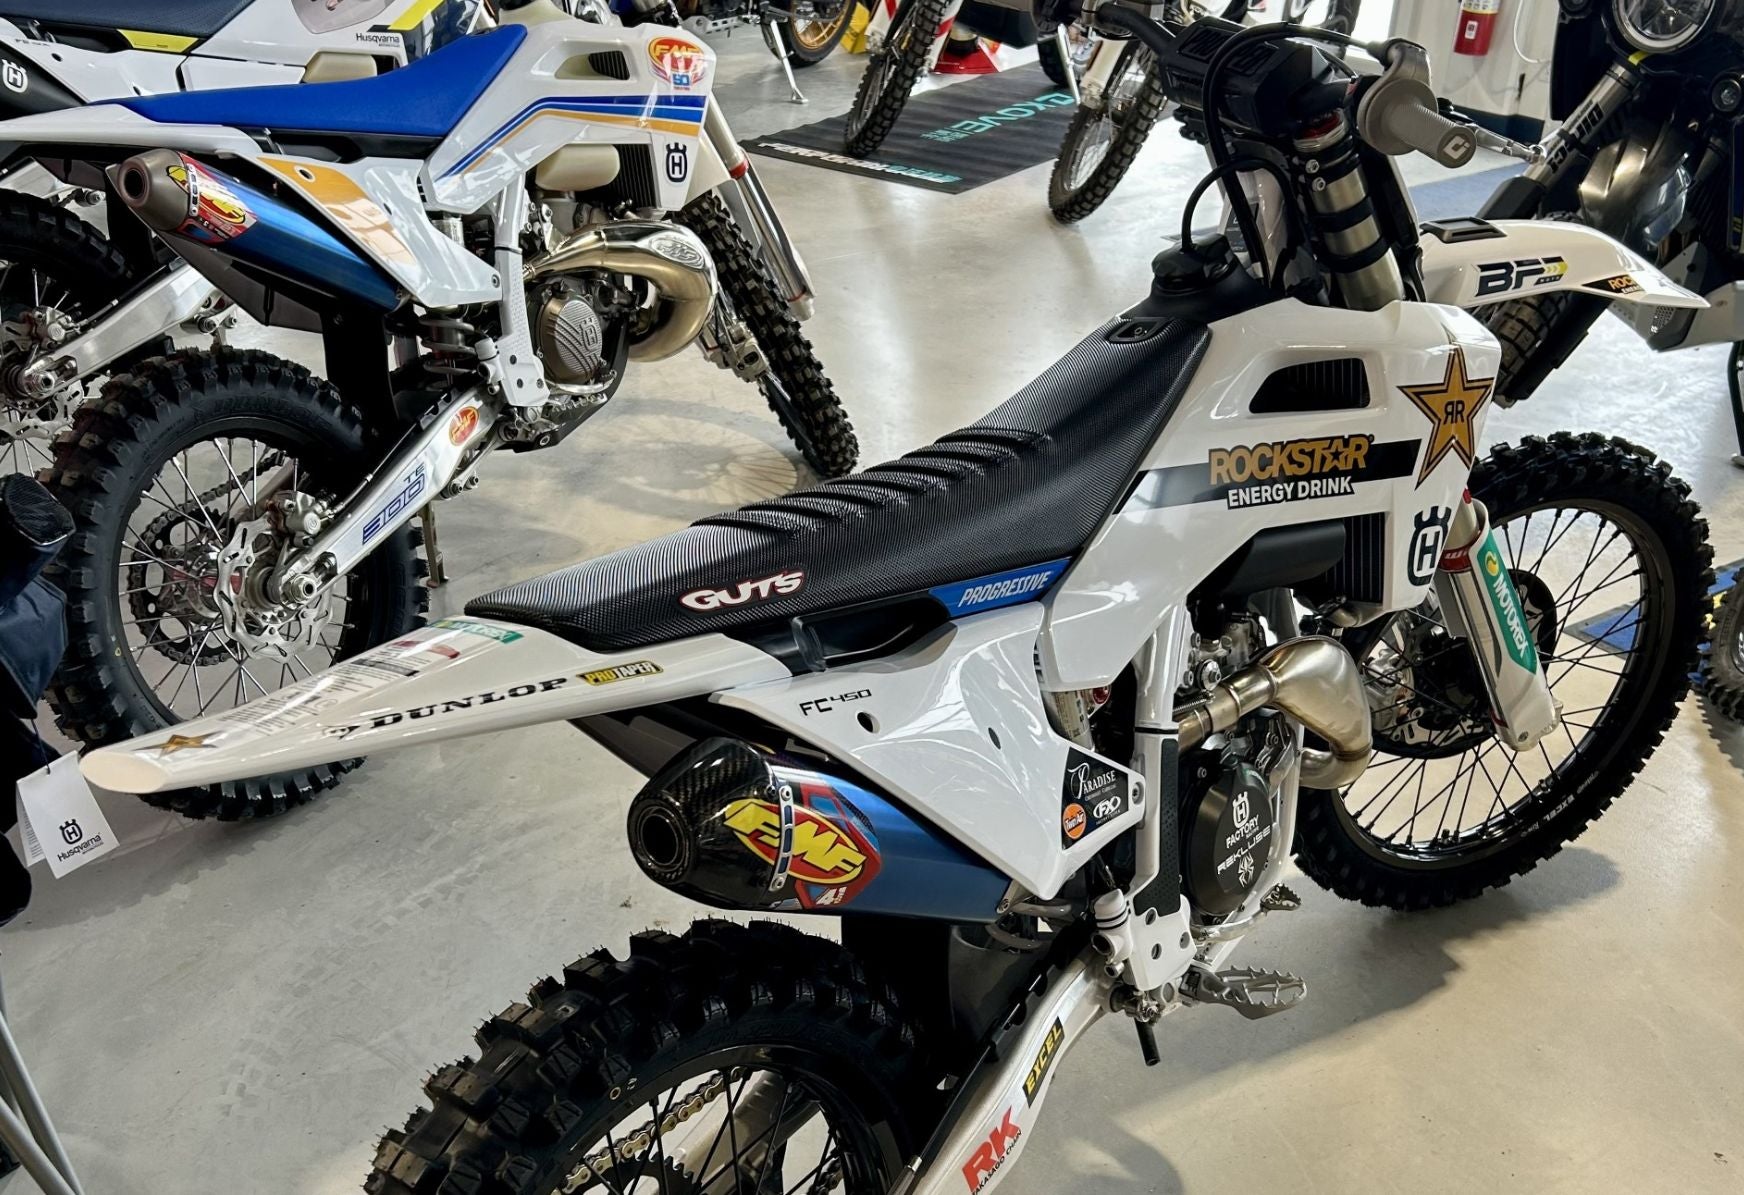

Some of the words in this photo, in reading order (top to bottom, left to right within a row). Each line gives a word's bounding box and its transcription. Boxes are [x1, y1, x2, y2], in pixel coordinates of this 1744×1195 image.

[356, 33, 400, 44] Husqvarna
[404, 462, 425, 484] TE
[1210, 436, 1369, 485] ROCKSTAR
[1228, 482, 1295, 507] ENERGY
[1297, 476, 1352, 499] DRINK
[681, 572, 803, 610] GUTS
[958, 571, 1052, 608] PROGRESSIVE
[1493, 573, 1529, 659] MOTOREX
[585, 661, 656, 685] PROTAPER
[369, 677, 568, 730] DUNLOP
[57, 834, 102, 861] Husqvarna
[724, 802, 867, 873] FMF
[1217, 825, 1270, 875] REKLUSE
[1226, 814, 1260, 849] FACTORY
[1025, 1025, 1062, 1095] EXCEL
[962, 1106, 1021, 1193] RK
